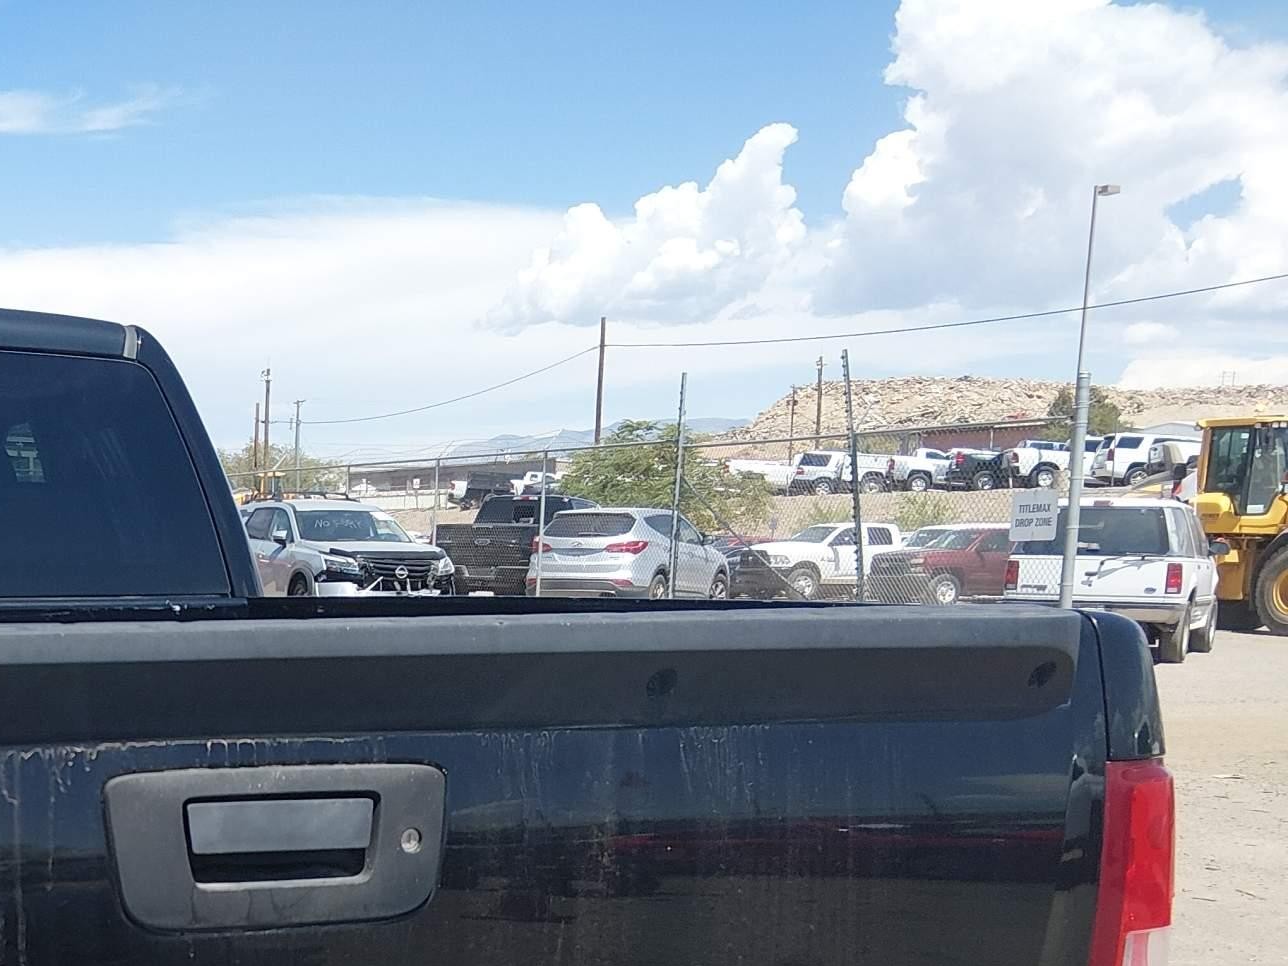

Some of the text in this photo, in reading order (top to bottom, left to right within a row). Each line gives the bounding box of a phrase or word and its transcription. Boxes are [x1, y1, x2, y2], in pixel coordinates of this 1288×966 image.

[1018, 503, 1051, 514] TITLEMAX
[1014, 516, 1053, 528] DROP ZONE
